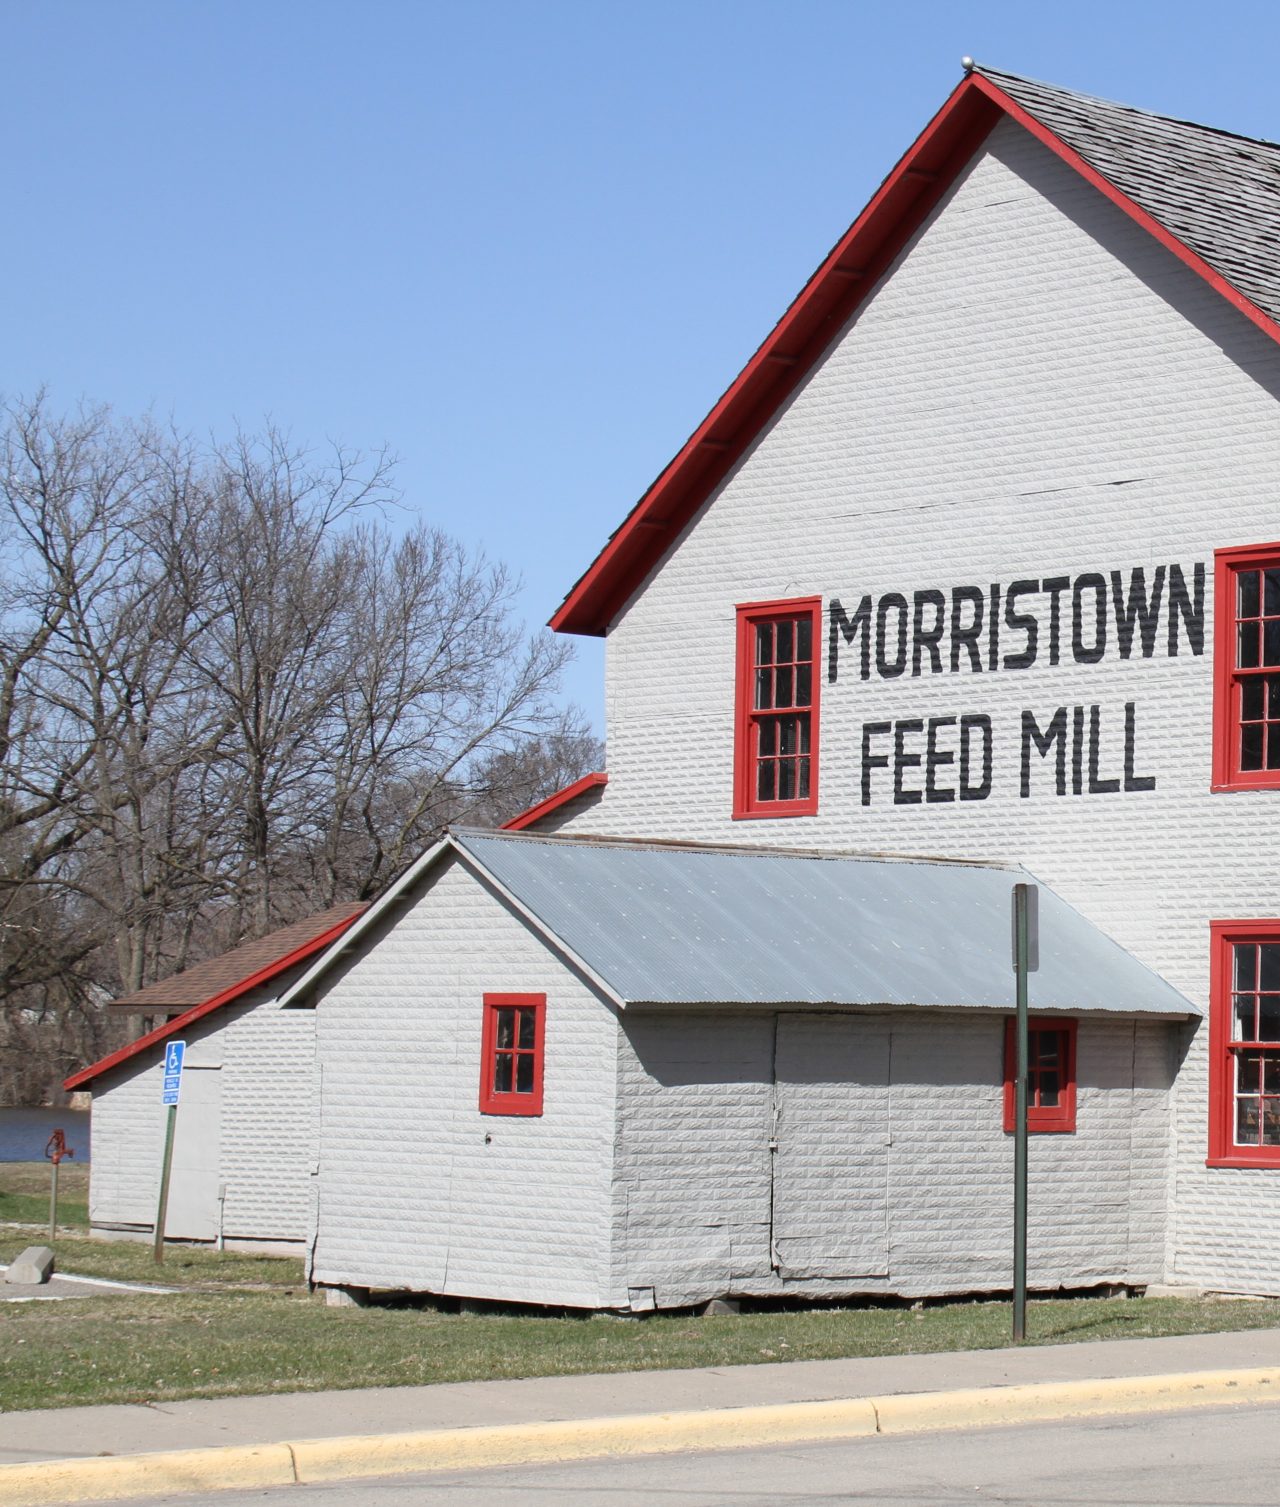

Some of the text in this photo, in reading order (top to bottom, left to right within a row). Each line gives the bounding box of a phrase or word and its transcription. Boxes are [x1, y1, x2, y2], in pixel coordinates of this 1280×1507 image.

[828, 561, 1205, 683] MORRISTOWN
[861, 701, 1156, 806] FEED MILL
